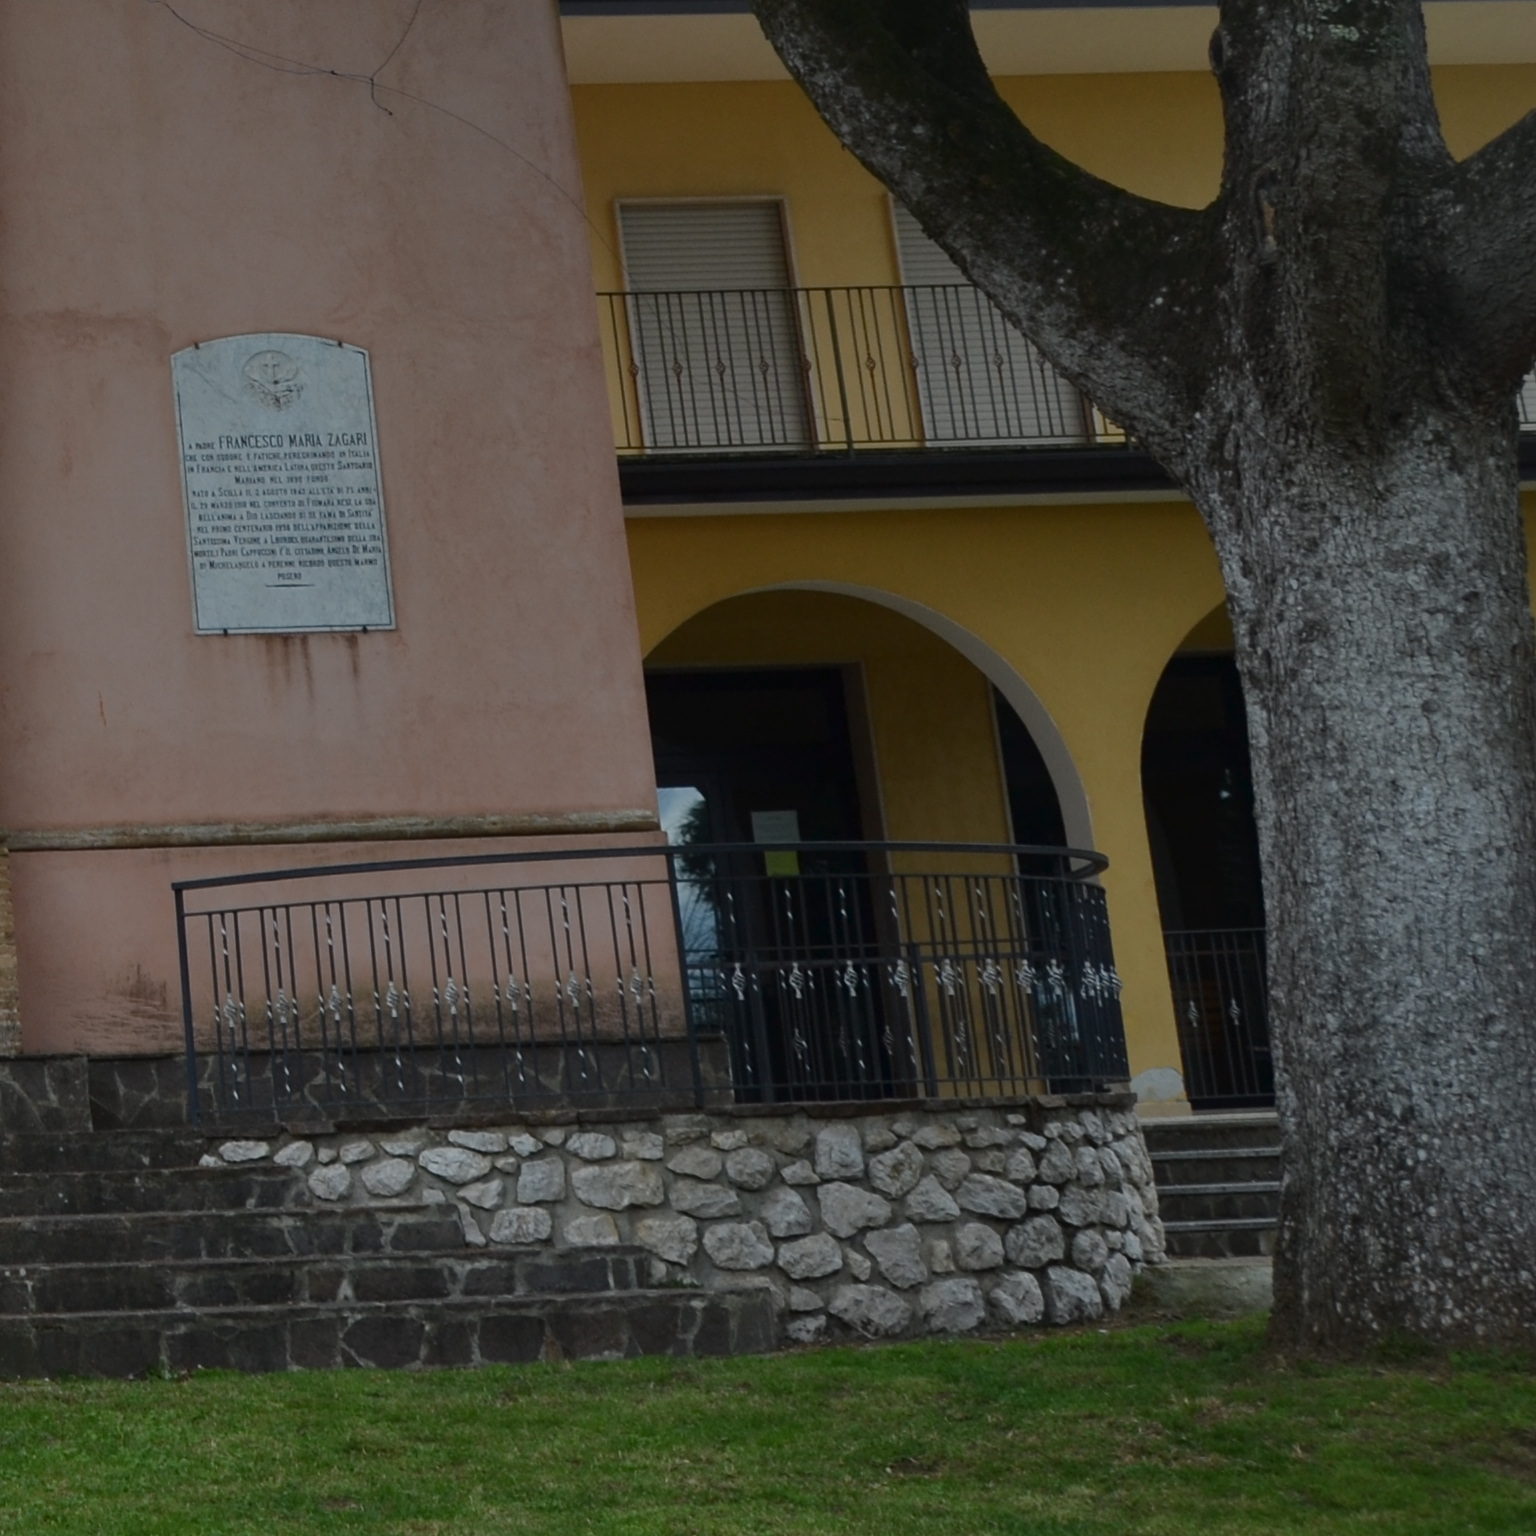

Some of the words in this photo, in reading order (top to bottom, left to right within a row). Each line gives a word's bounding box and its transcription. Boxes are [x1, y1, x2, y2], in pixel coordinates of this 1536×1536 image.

[218, 434, 284, 449] FRANCESCO
[288, 433, 323, 448] MARIA
[327, 432, 368, 447] ZAGARI
